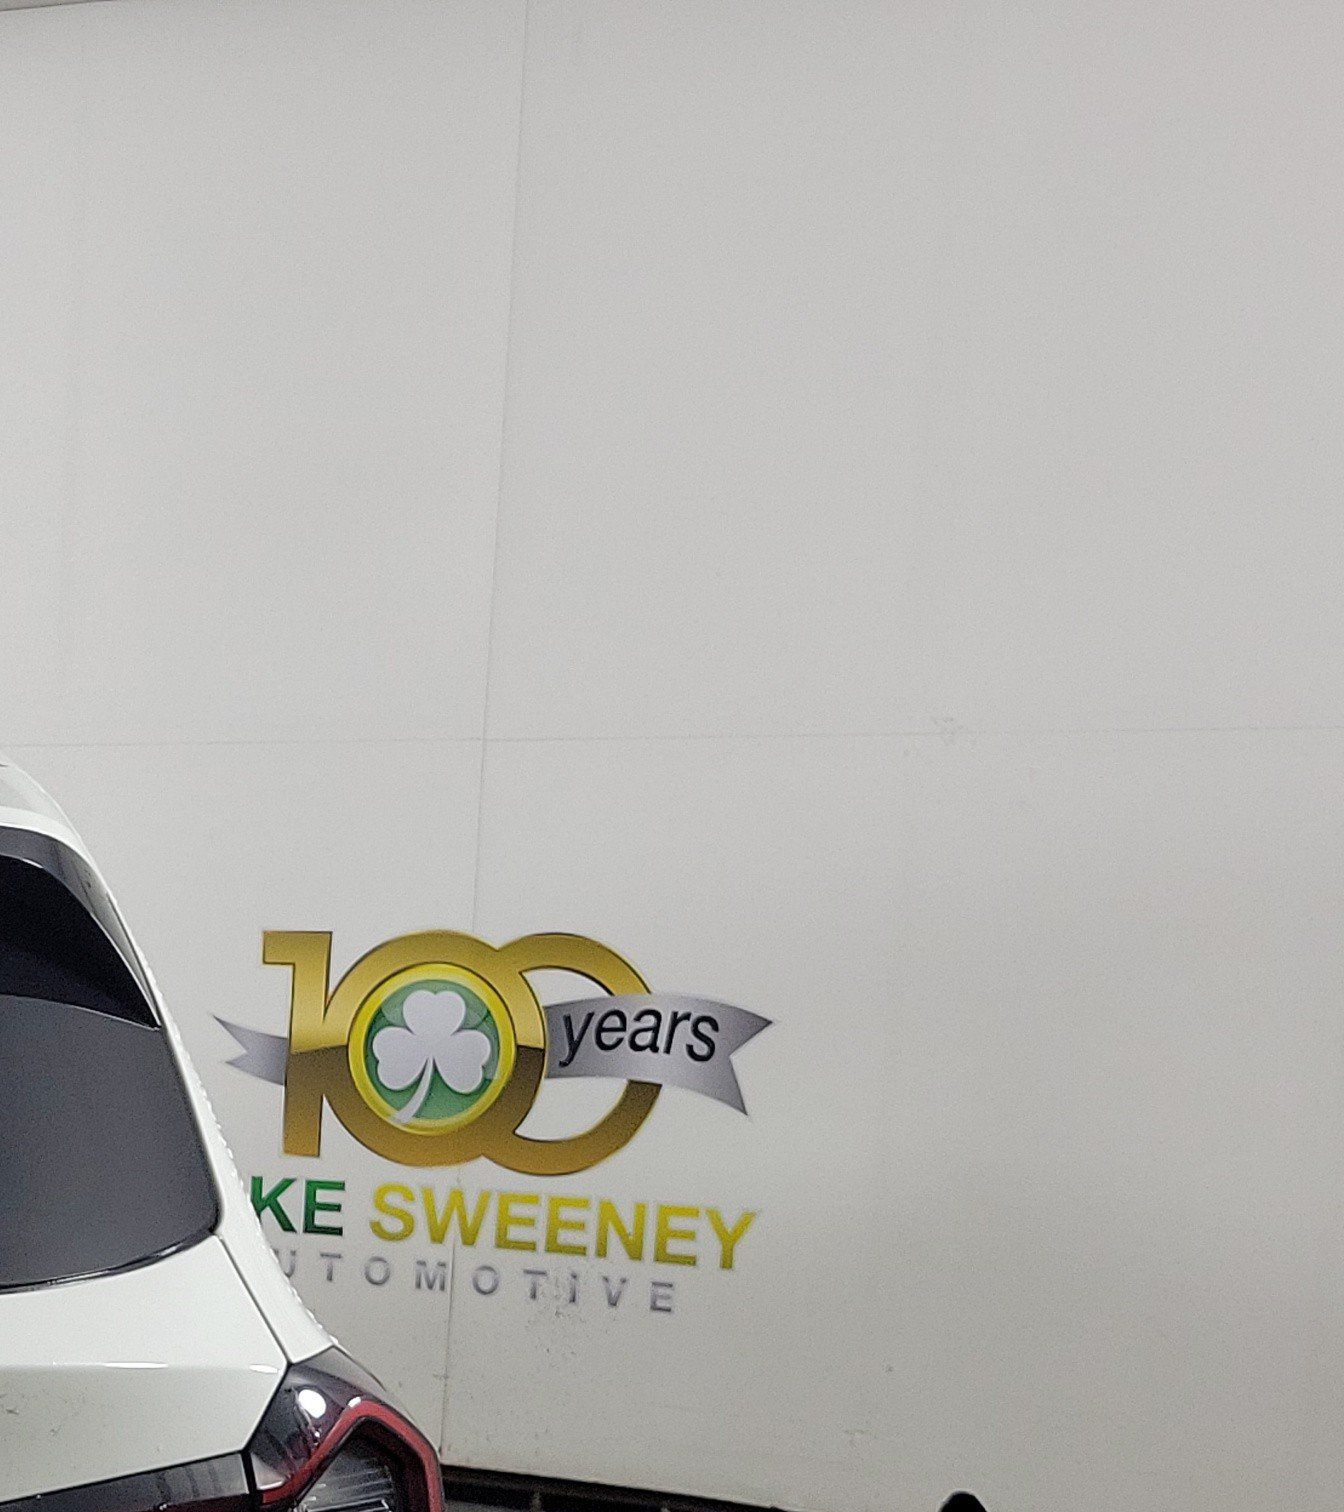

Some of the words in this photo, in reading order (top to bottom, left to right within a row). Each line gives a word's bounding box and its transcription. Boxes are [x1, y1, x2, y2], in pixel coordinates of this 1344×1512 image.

[262, 929, 662, 1176] 100
[558, 1006, 720, 1068] years
[250, 1176, 345, 1236] KE
[369, 1184, 761, 1270] SWEENEY
[272, 1249, 675, 1312] UTOMOTIVE
